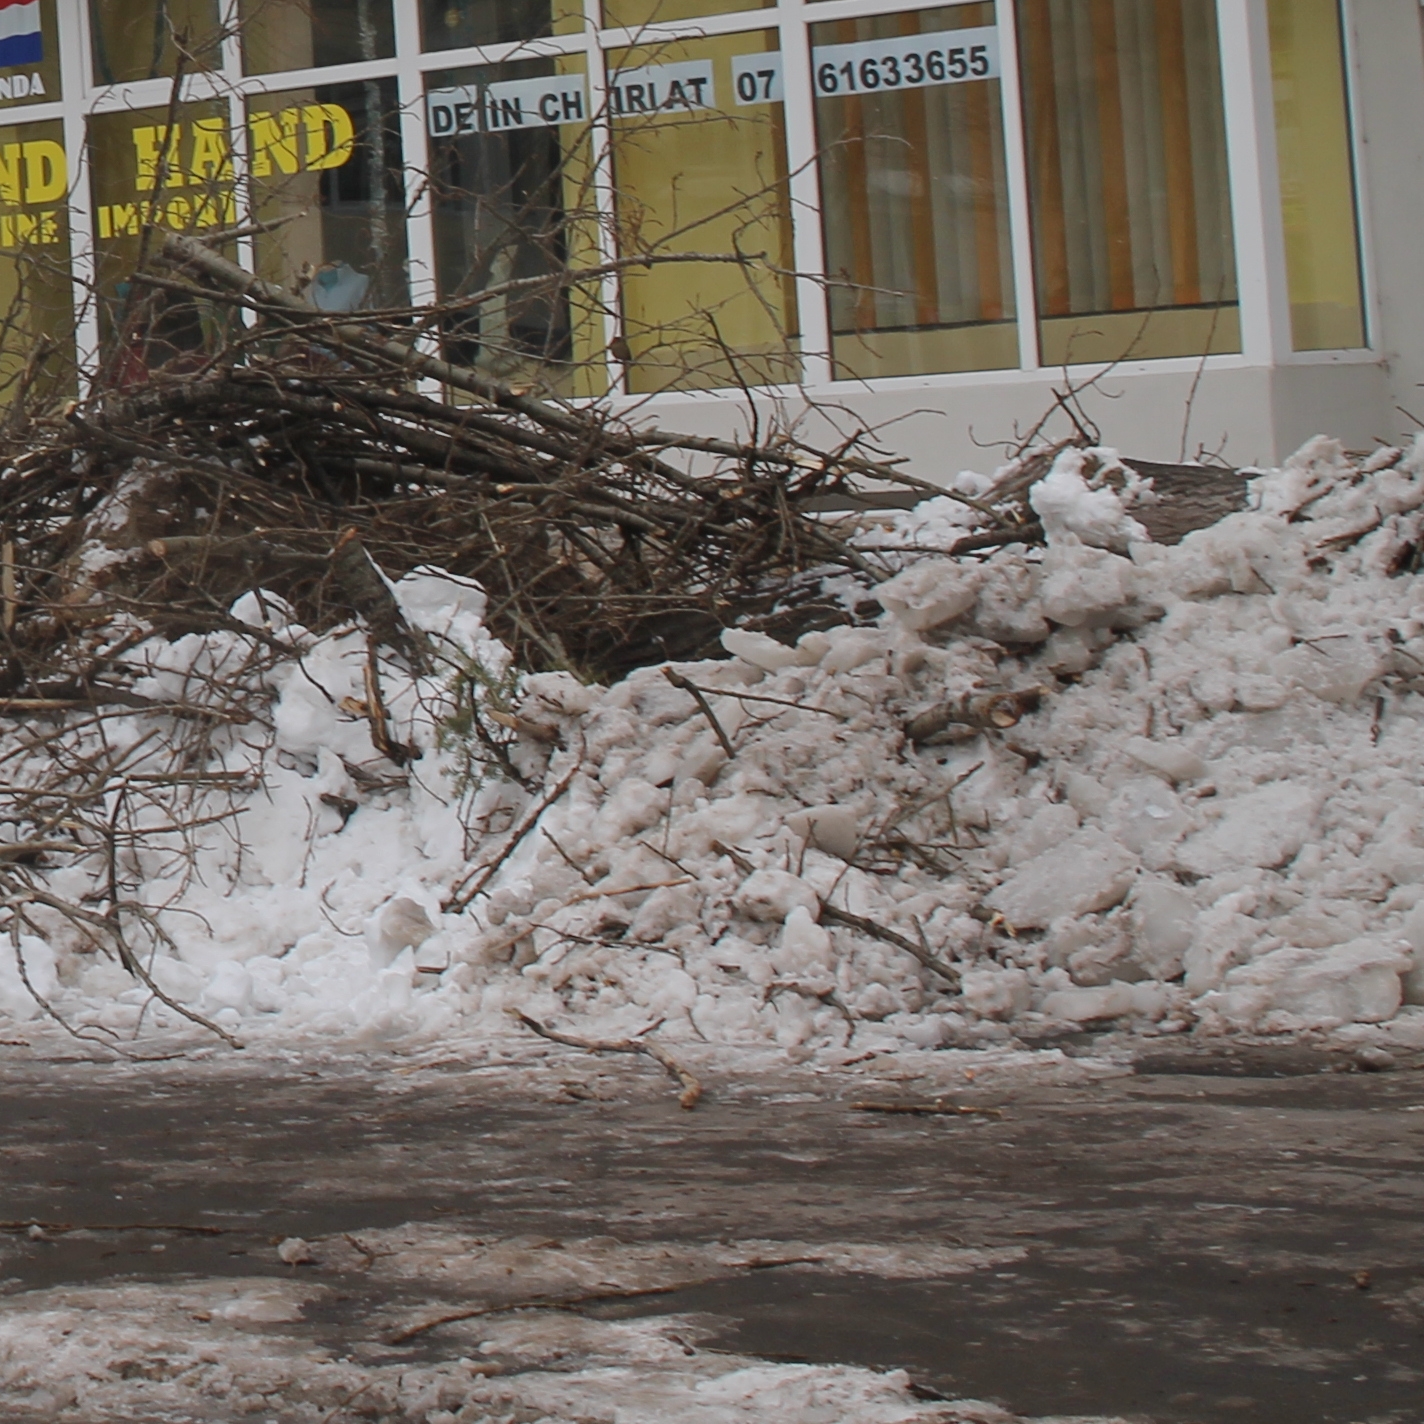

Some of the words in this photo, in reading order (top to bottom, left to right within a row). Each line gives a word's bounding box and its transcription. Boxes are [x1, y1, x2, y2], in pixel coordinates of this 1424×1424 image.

[432, 102, 473, 134] DE
[816, 44, 990, 94] 61633655
[132, 103, 354, 191] HAND
